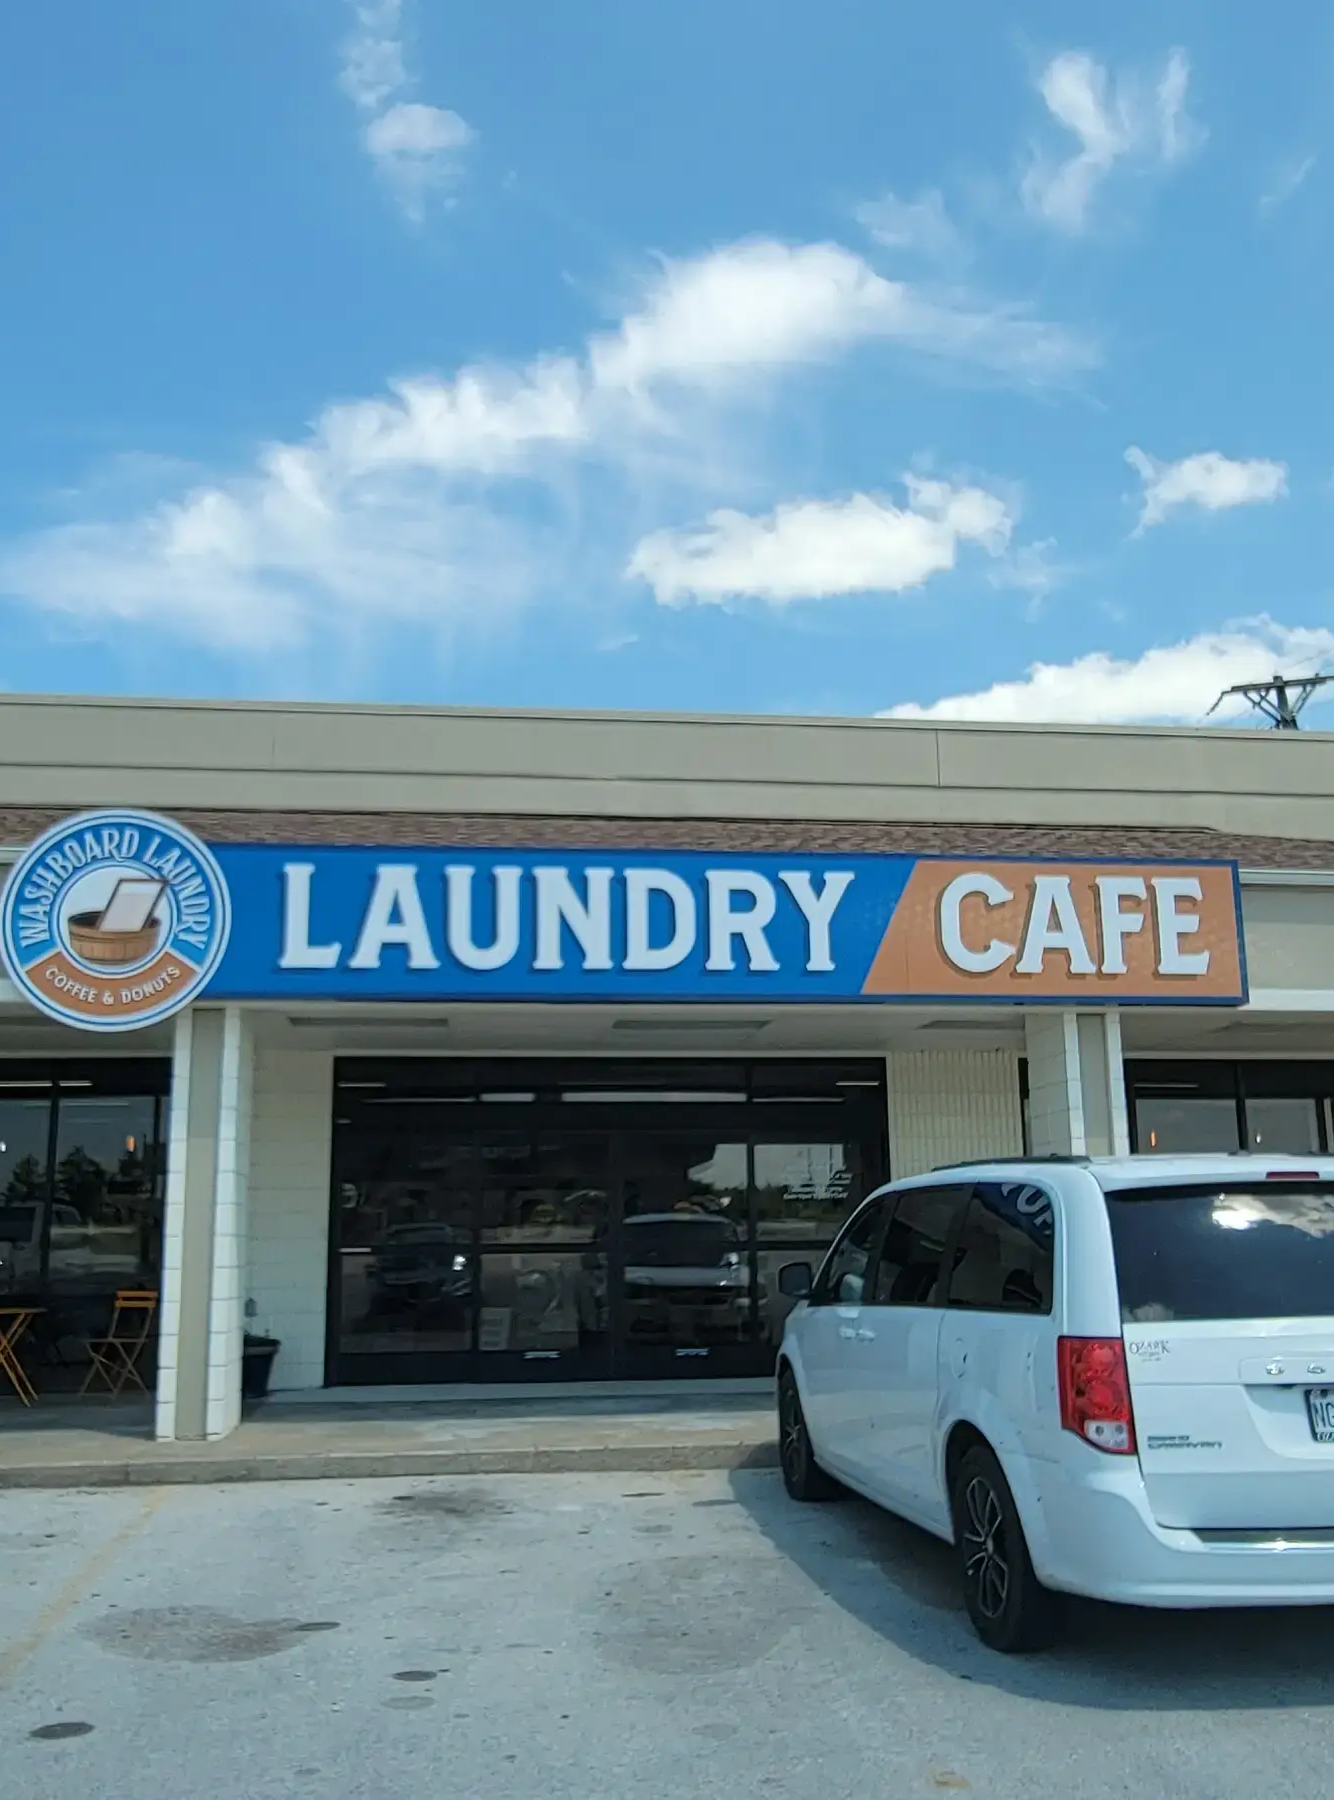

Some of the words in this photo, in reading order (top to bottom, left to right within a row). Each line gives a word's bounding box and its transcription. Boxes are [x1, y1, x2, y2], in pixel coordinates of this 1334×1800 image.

[18, 827, 140, 948] WASHBOARD
[143, 834, 211, 950] LAUNDRY
[278, 862, 856, 972] LAUNDRY
[939, 871, 1211, 975] CAFE
[45, 965, 98, 1004] COFFEE
[102, 991, 115, 1006] &
[121, 967, 182, 1004] DONUTS
